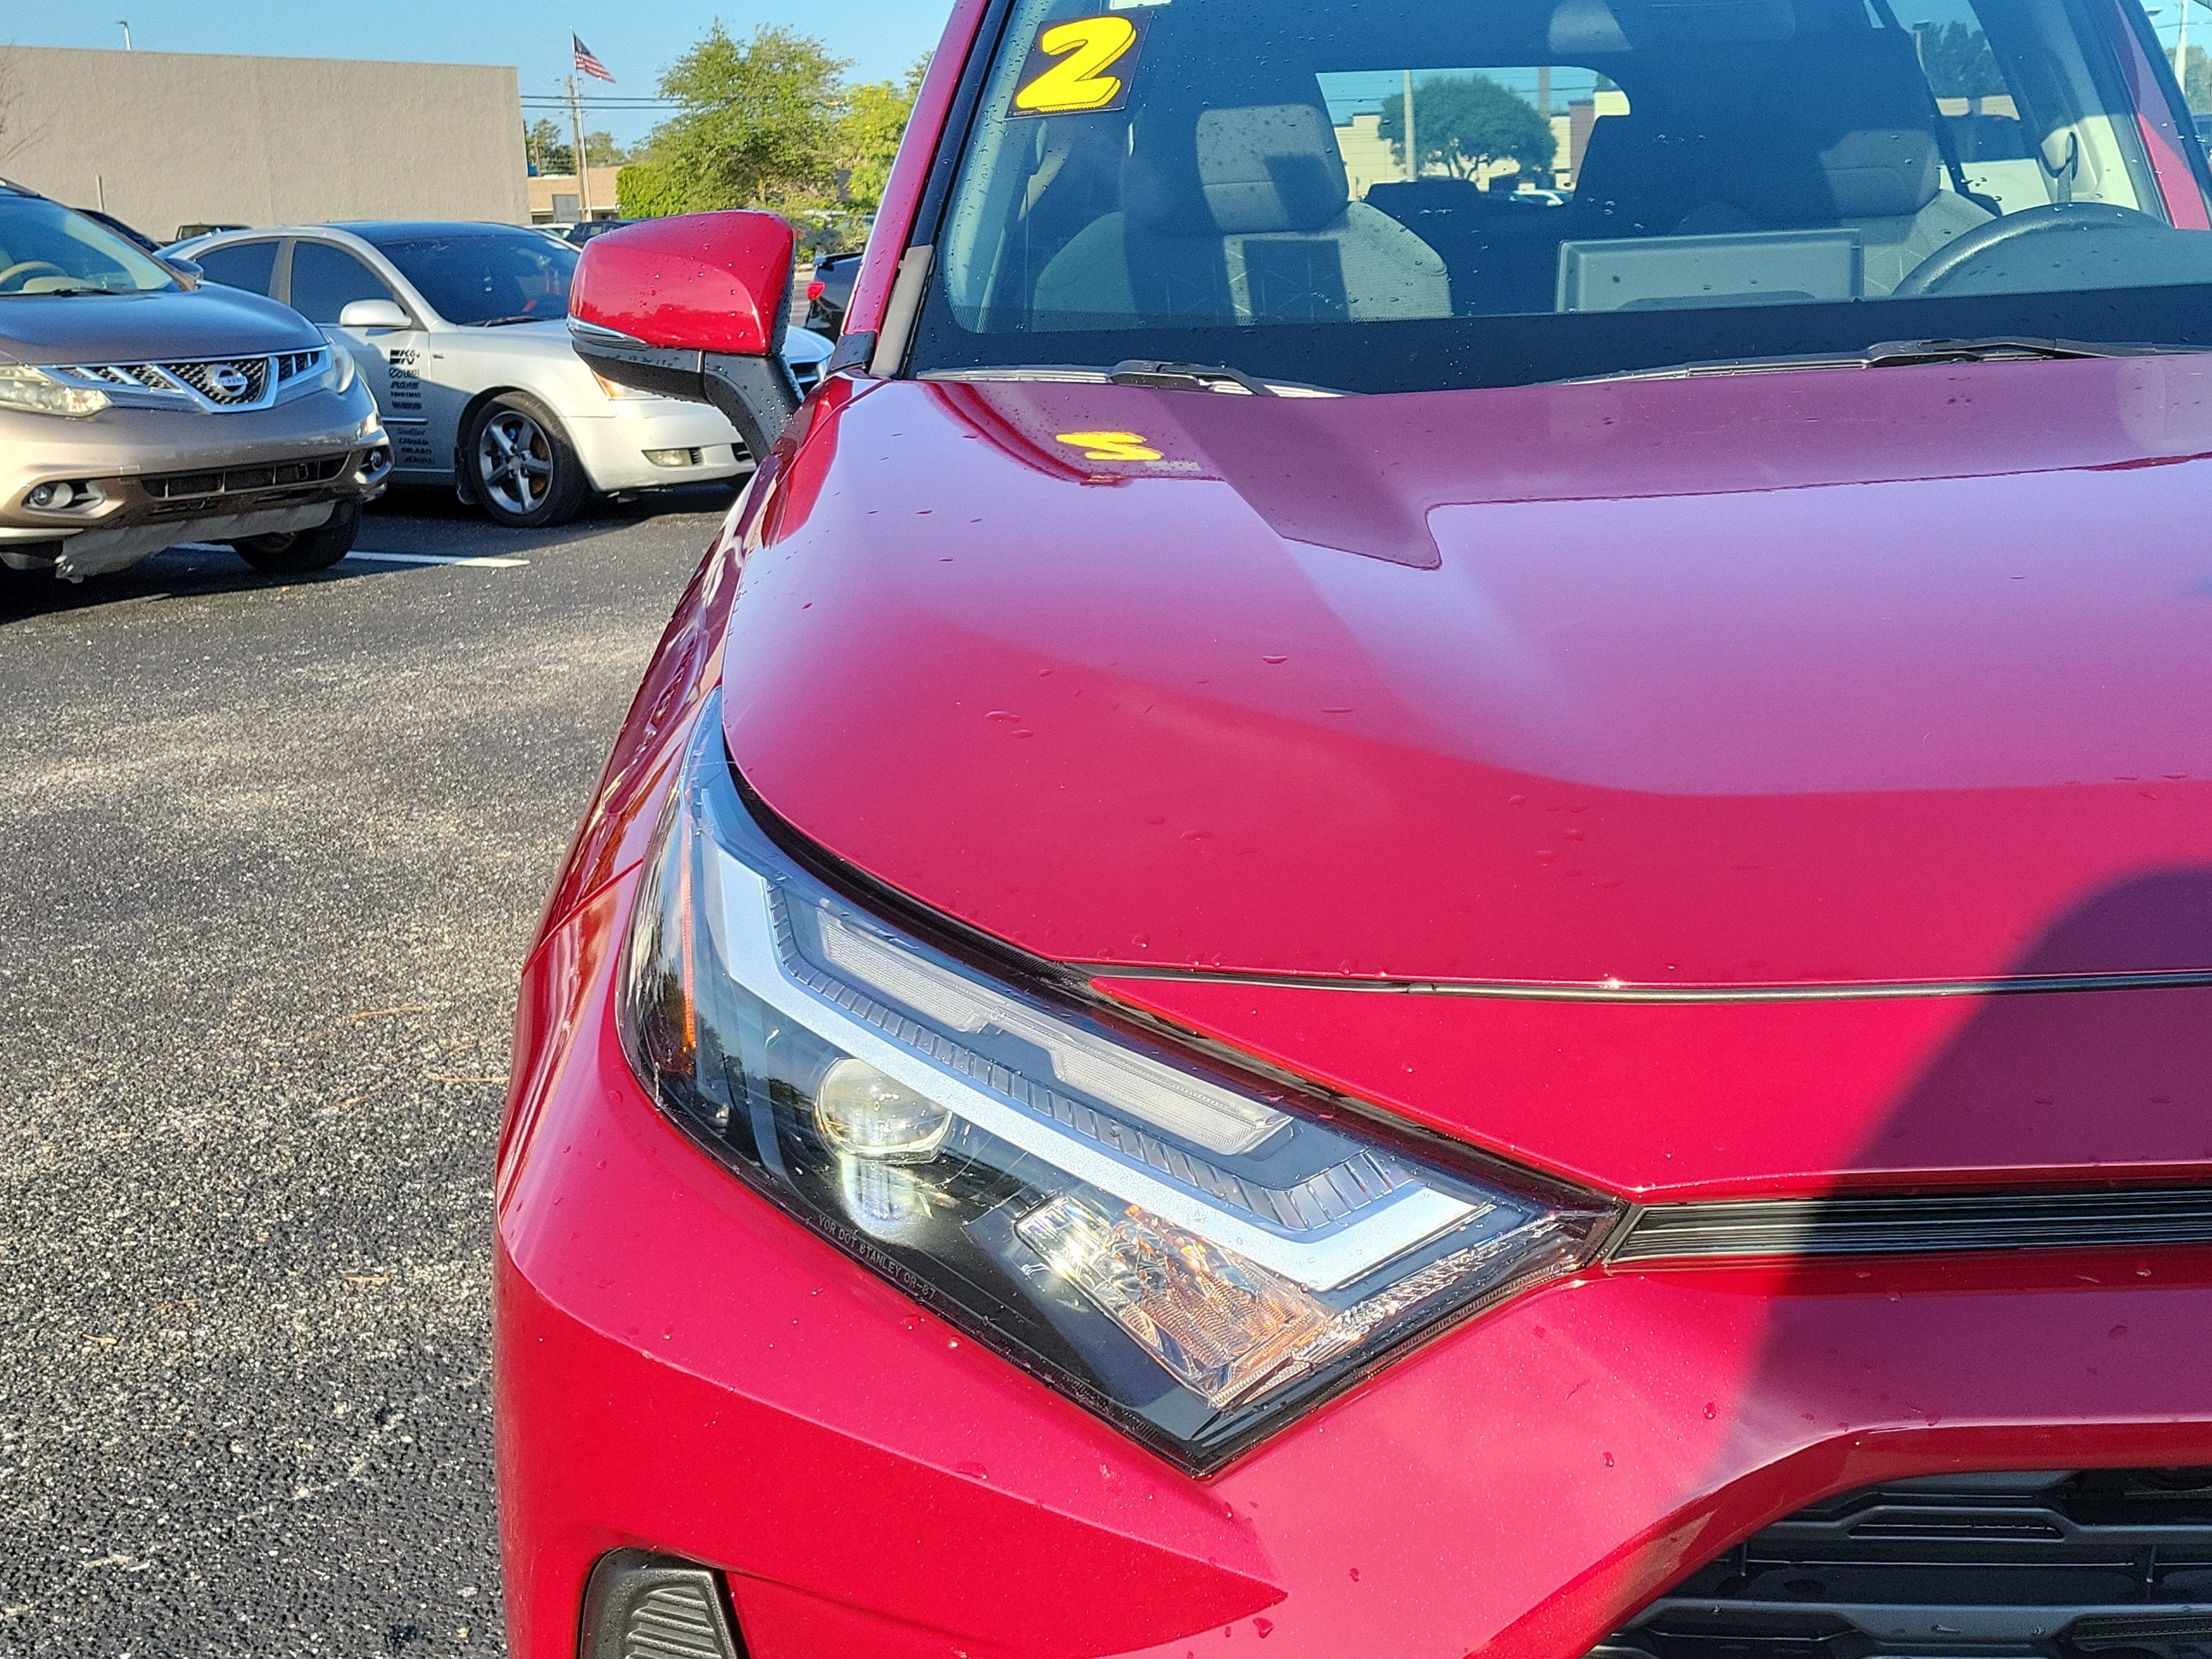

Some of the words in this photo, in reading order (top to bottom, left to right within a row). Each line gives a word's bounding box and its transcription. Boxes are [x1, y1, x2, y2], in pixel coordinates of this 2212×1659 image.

[1016, 16, 1137, 112] 2
[819, 1215, 836, 1235] VOR
[838, 1228, 857, 1248] DOT
[860, 1243, 902, 1277] STANLEY
